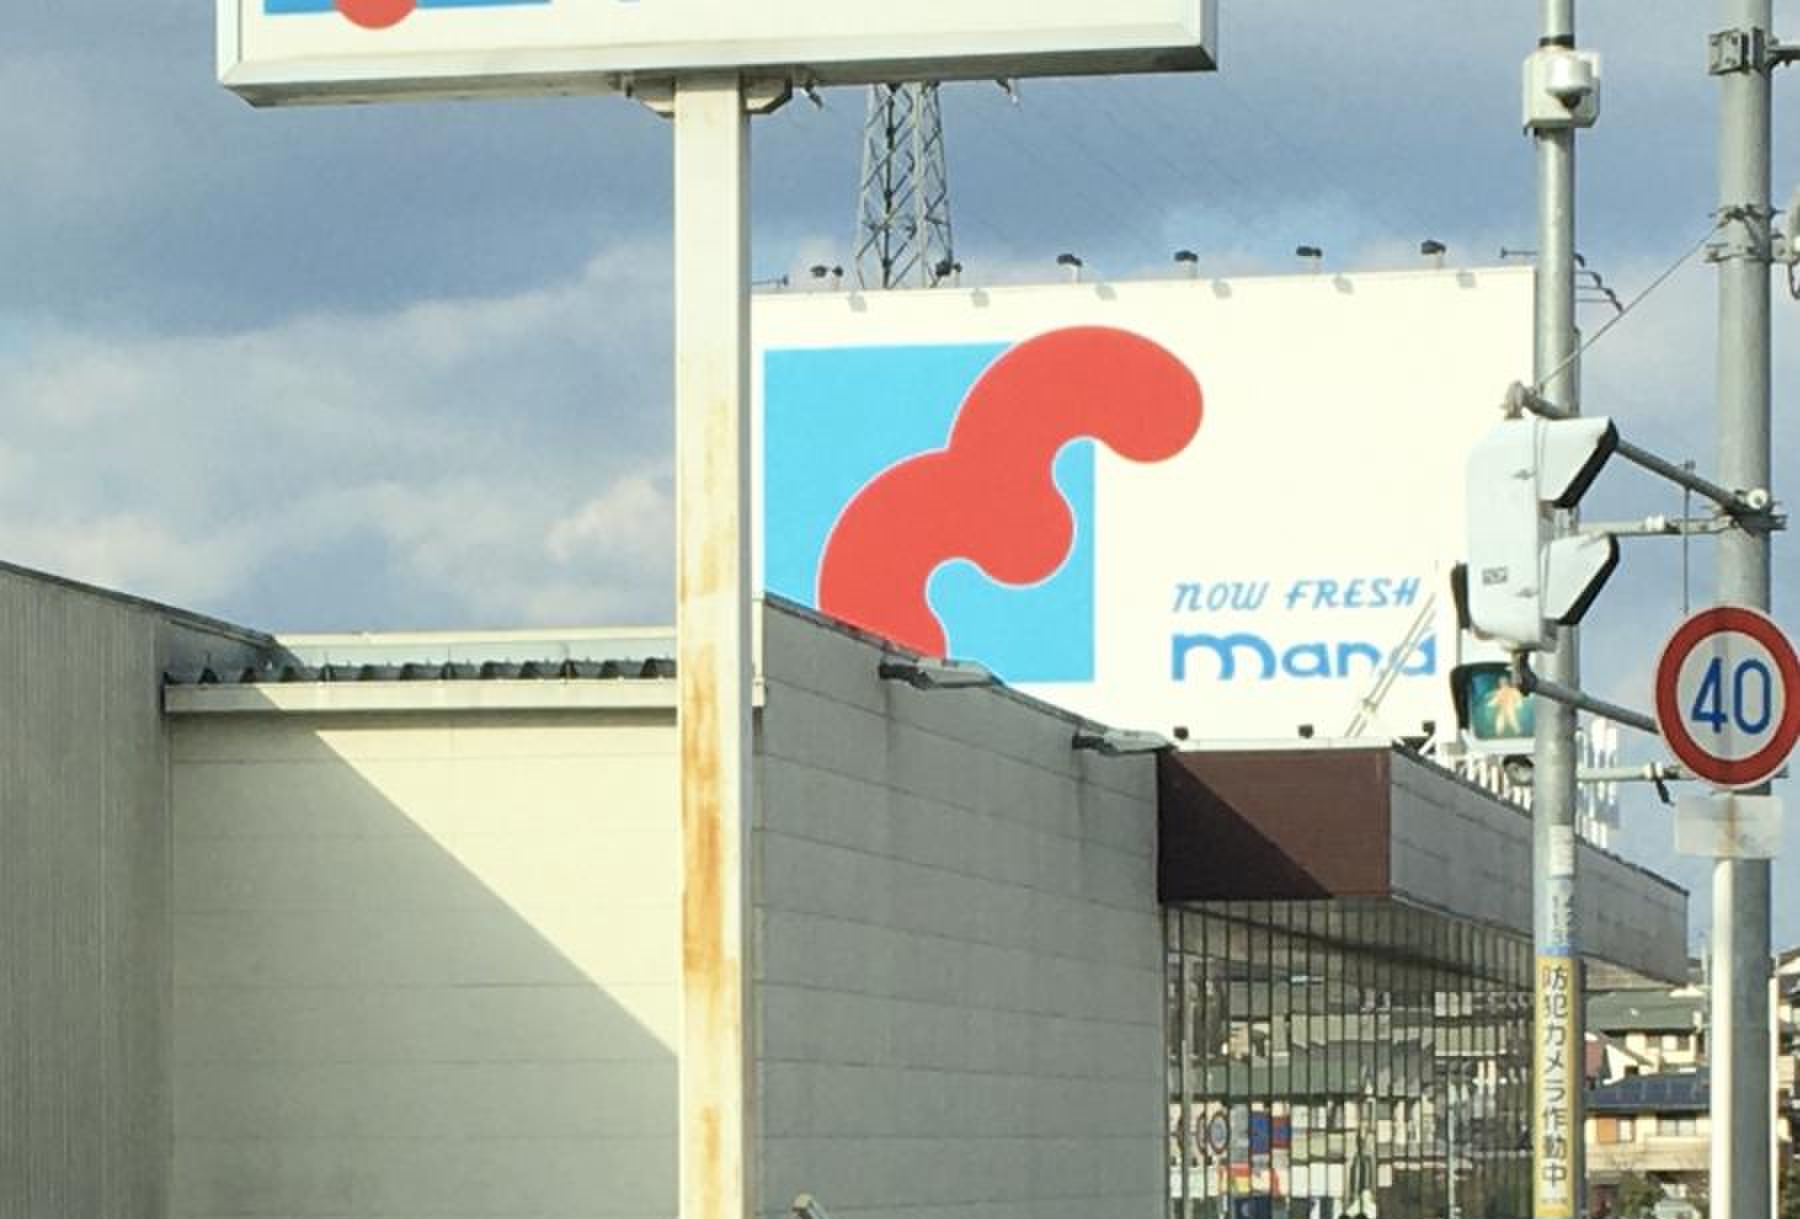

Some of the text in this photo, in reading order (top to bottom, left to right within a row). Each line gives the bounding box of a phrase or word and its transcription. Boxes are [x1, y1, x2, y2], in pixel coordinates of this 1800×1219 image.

[1283, 577, 1421, 610] FRESH
[1690, 656, 1772, 736] 40
[1540, 963, 1569, 1188] 防犯カメラ作動中
